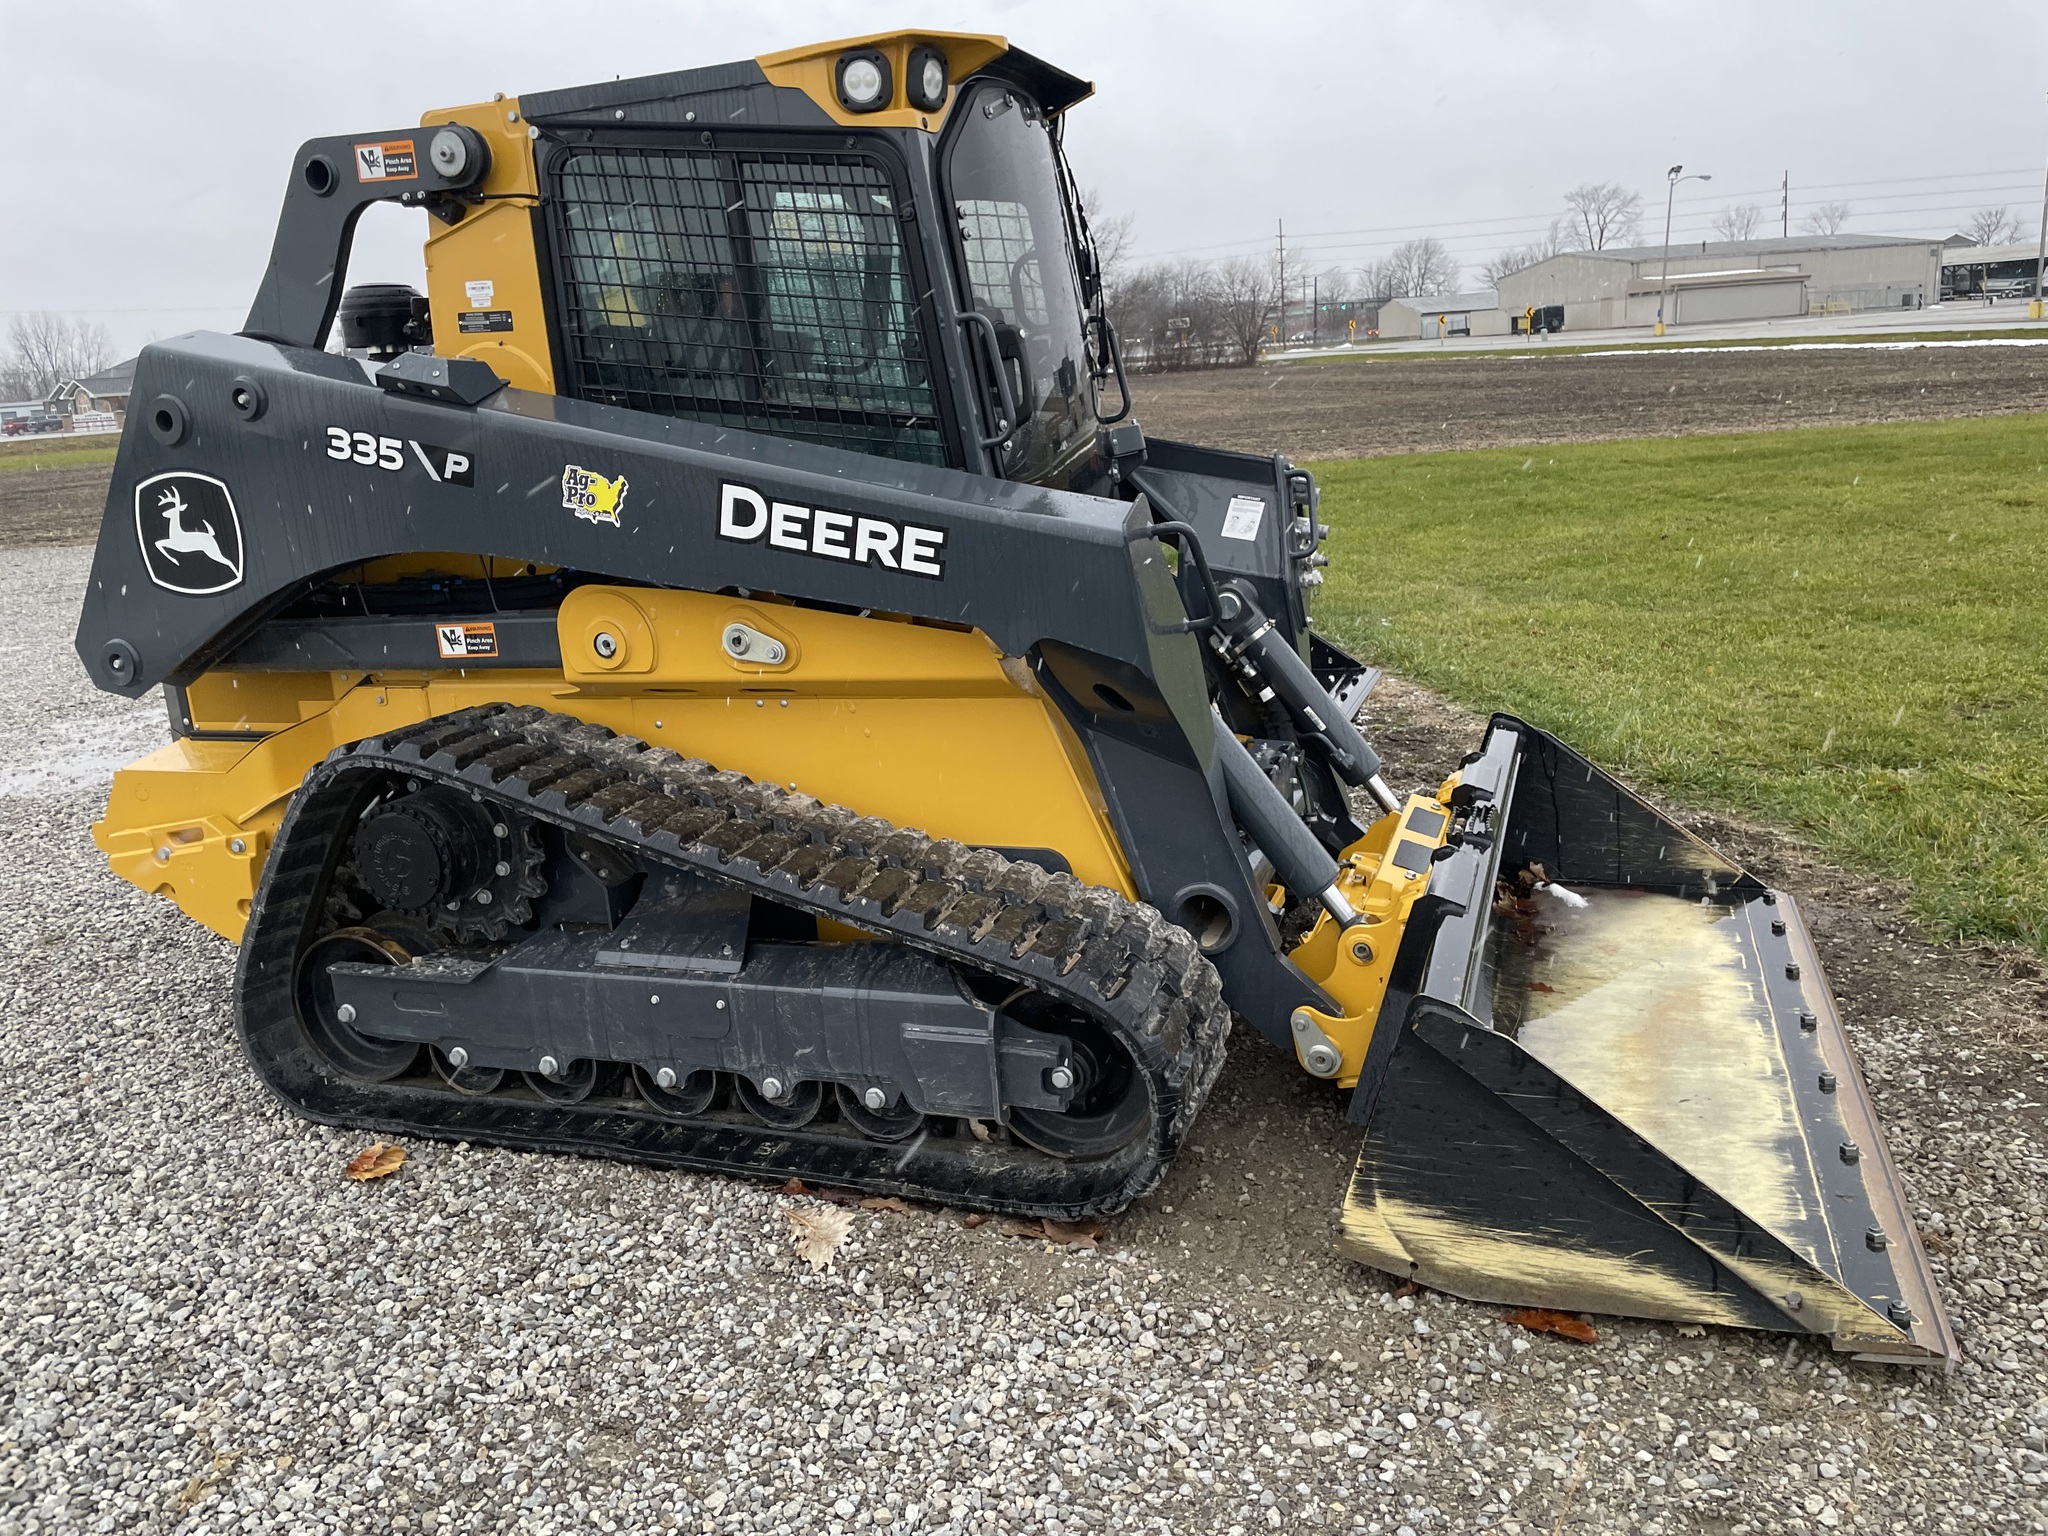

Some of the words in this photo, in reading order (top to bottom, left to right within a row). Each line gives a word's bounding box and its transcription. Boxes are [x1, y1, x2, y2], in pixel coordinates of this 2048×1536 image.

[326, 426, 404, 471] 335
[566, 486, 597, 506] Pro
[720, 483, 944, 576] DEERE
